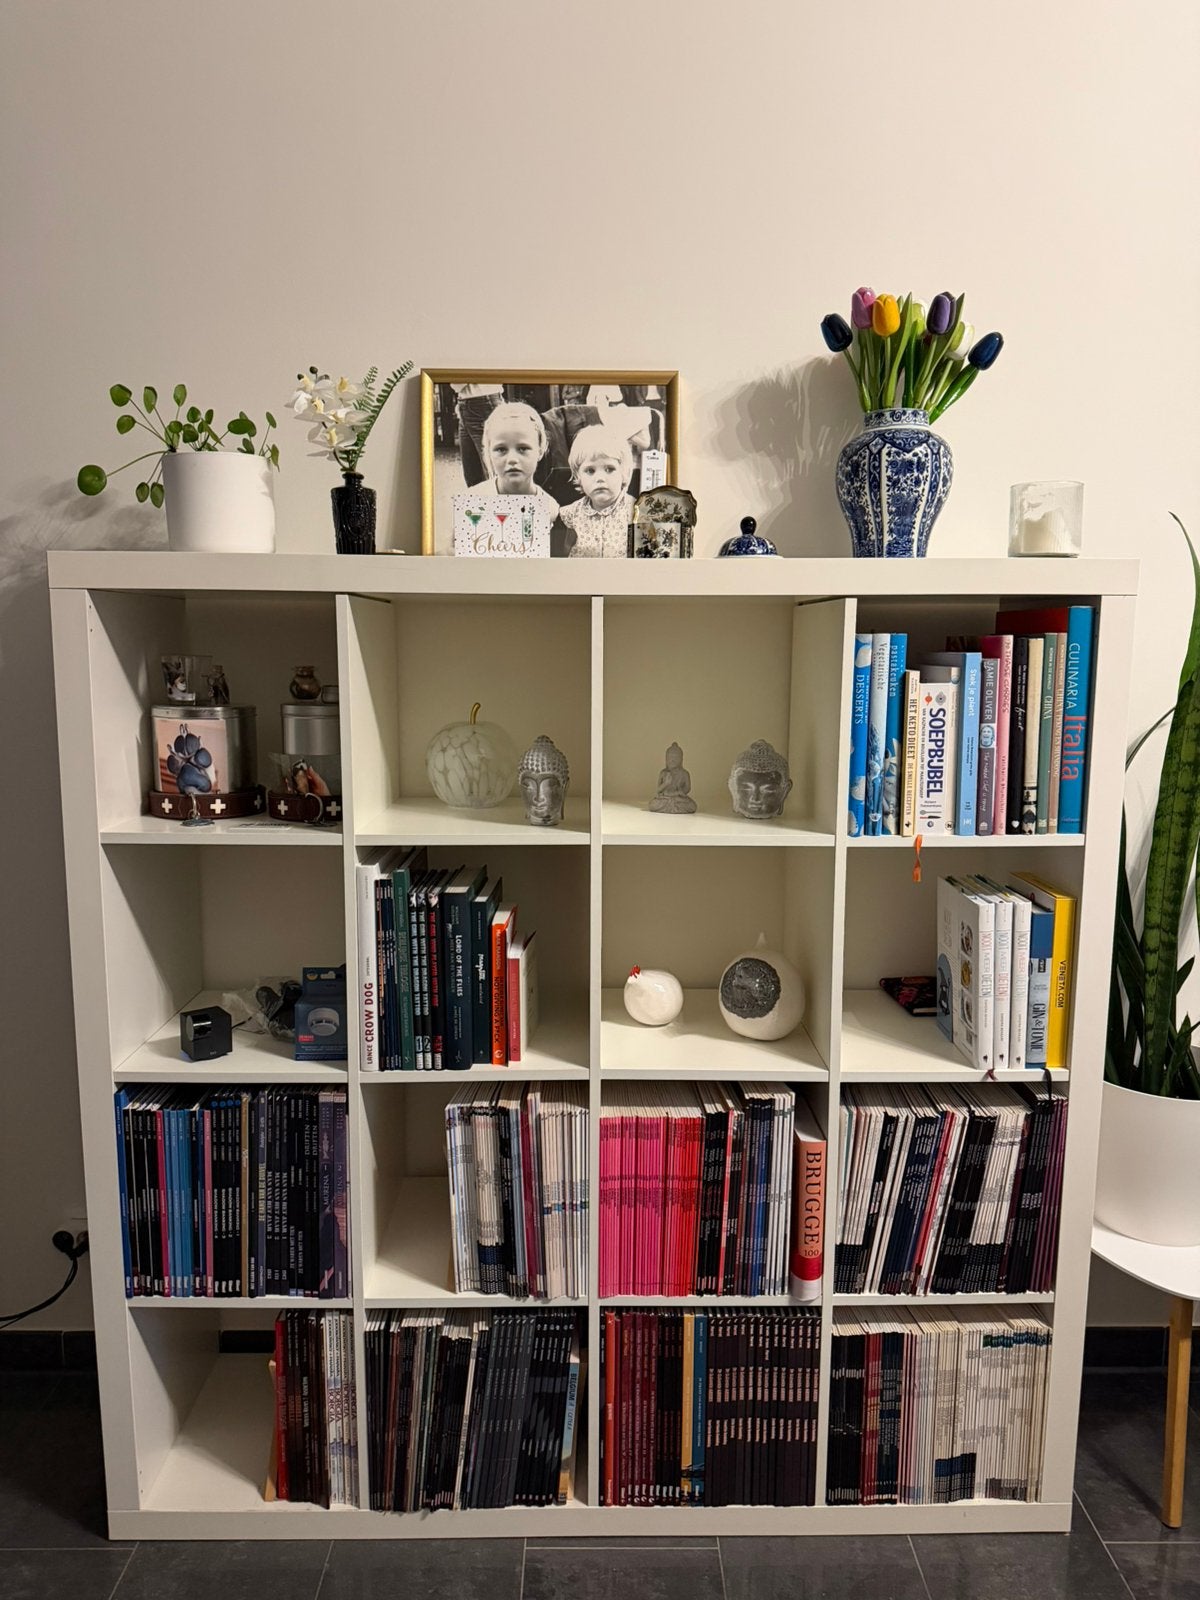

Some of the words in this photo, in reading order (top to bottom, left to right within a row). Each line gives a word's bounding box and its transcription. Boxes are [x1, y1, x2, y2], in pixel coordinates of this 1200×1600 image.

[877, 643, 887, 690] Vegetarische
[889, 645, 898, 697] pastakeuken
[969, 669, 977, 686] Stek
[985, 661, 995, 687] JAMIE
[1065, 643, 1080, 709] CULINARIA
[855, 674, 865, 724] DESSERTS
[909, 699, 917, 714] HET
[968, 698, 976, 716] plant
[984, 689, 994, 720] OLIVER
[1002, 679, 1010, 713] CURRIES
[1043, 696, 1053, 719] CHINA
[908, 716, 917, 736] KETO
[907, 738, 916, 760] DIEET
[1061, 714, 1086, 781] Italia
[455, 935, 463, 953] LORD
[456, 955, 462, 964] OF
[364, 982, 373, 1005] DOG
[980, 974, 992, 997] DIETEN
[998, 972, 1008, 996] DIETEN
[365, 1009, 374, 1043] CROW
[804, 1151, 822, 1245] BRUGGE
[804, 1249, 819, 1257] 100
[569, 1373, 577, 1400] BELGIUM
